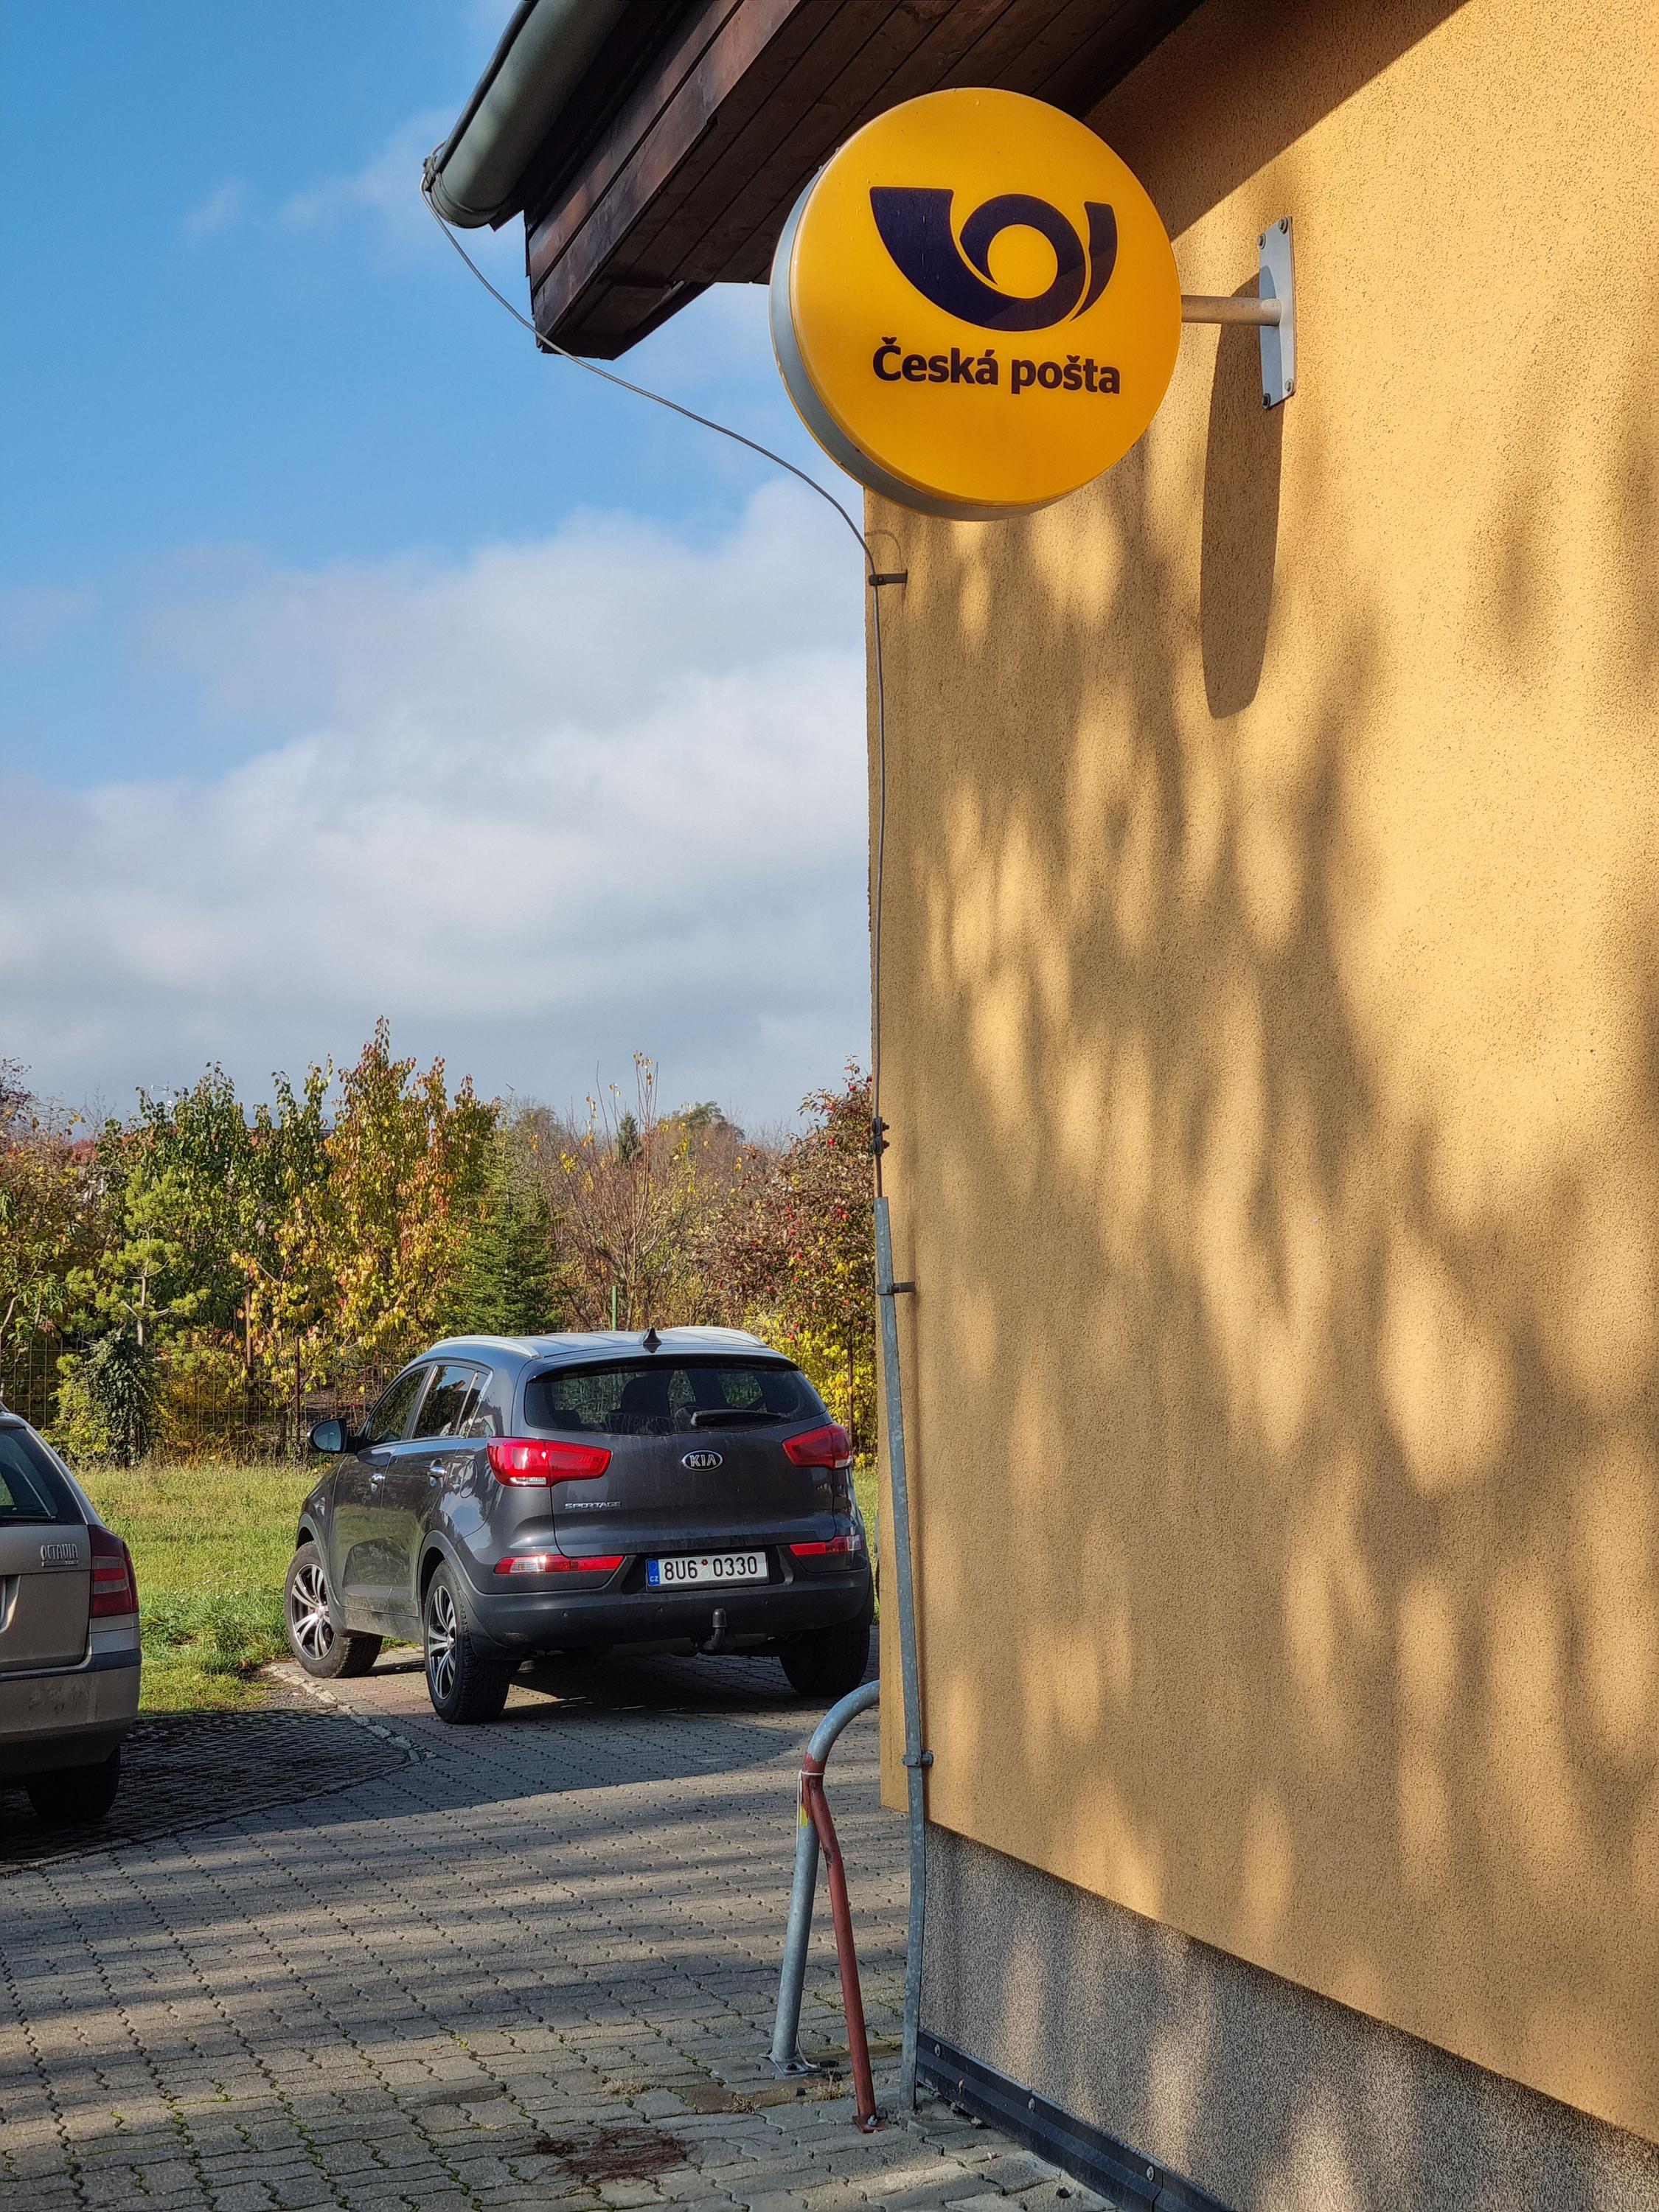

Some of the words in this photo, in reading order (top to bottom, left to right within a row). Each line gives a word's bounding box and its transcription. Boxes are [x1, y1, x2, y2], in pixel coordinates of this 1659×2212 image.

[872, 336, 998, 386] Česká
[1011, 355, 1120, 394] pošta
[689, 1454, 717, 1467] KIA
[565, 1501, 621, 1509] SPORTAGE
[41, 1543, 78, 1561] OCTAVIA
[664, 1560, 698, 1580] 8U6
[712, 1556, 757, 1576] 0330
